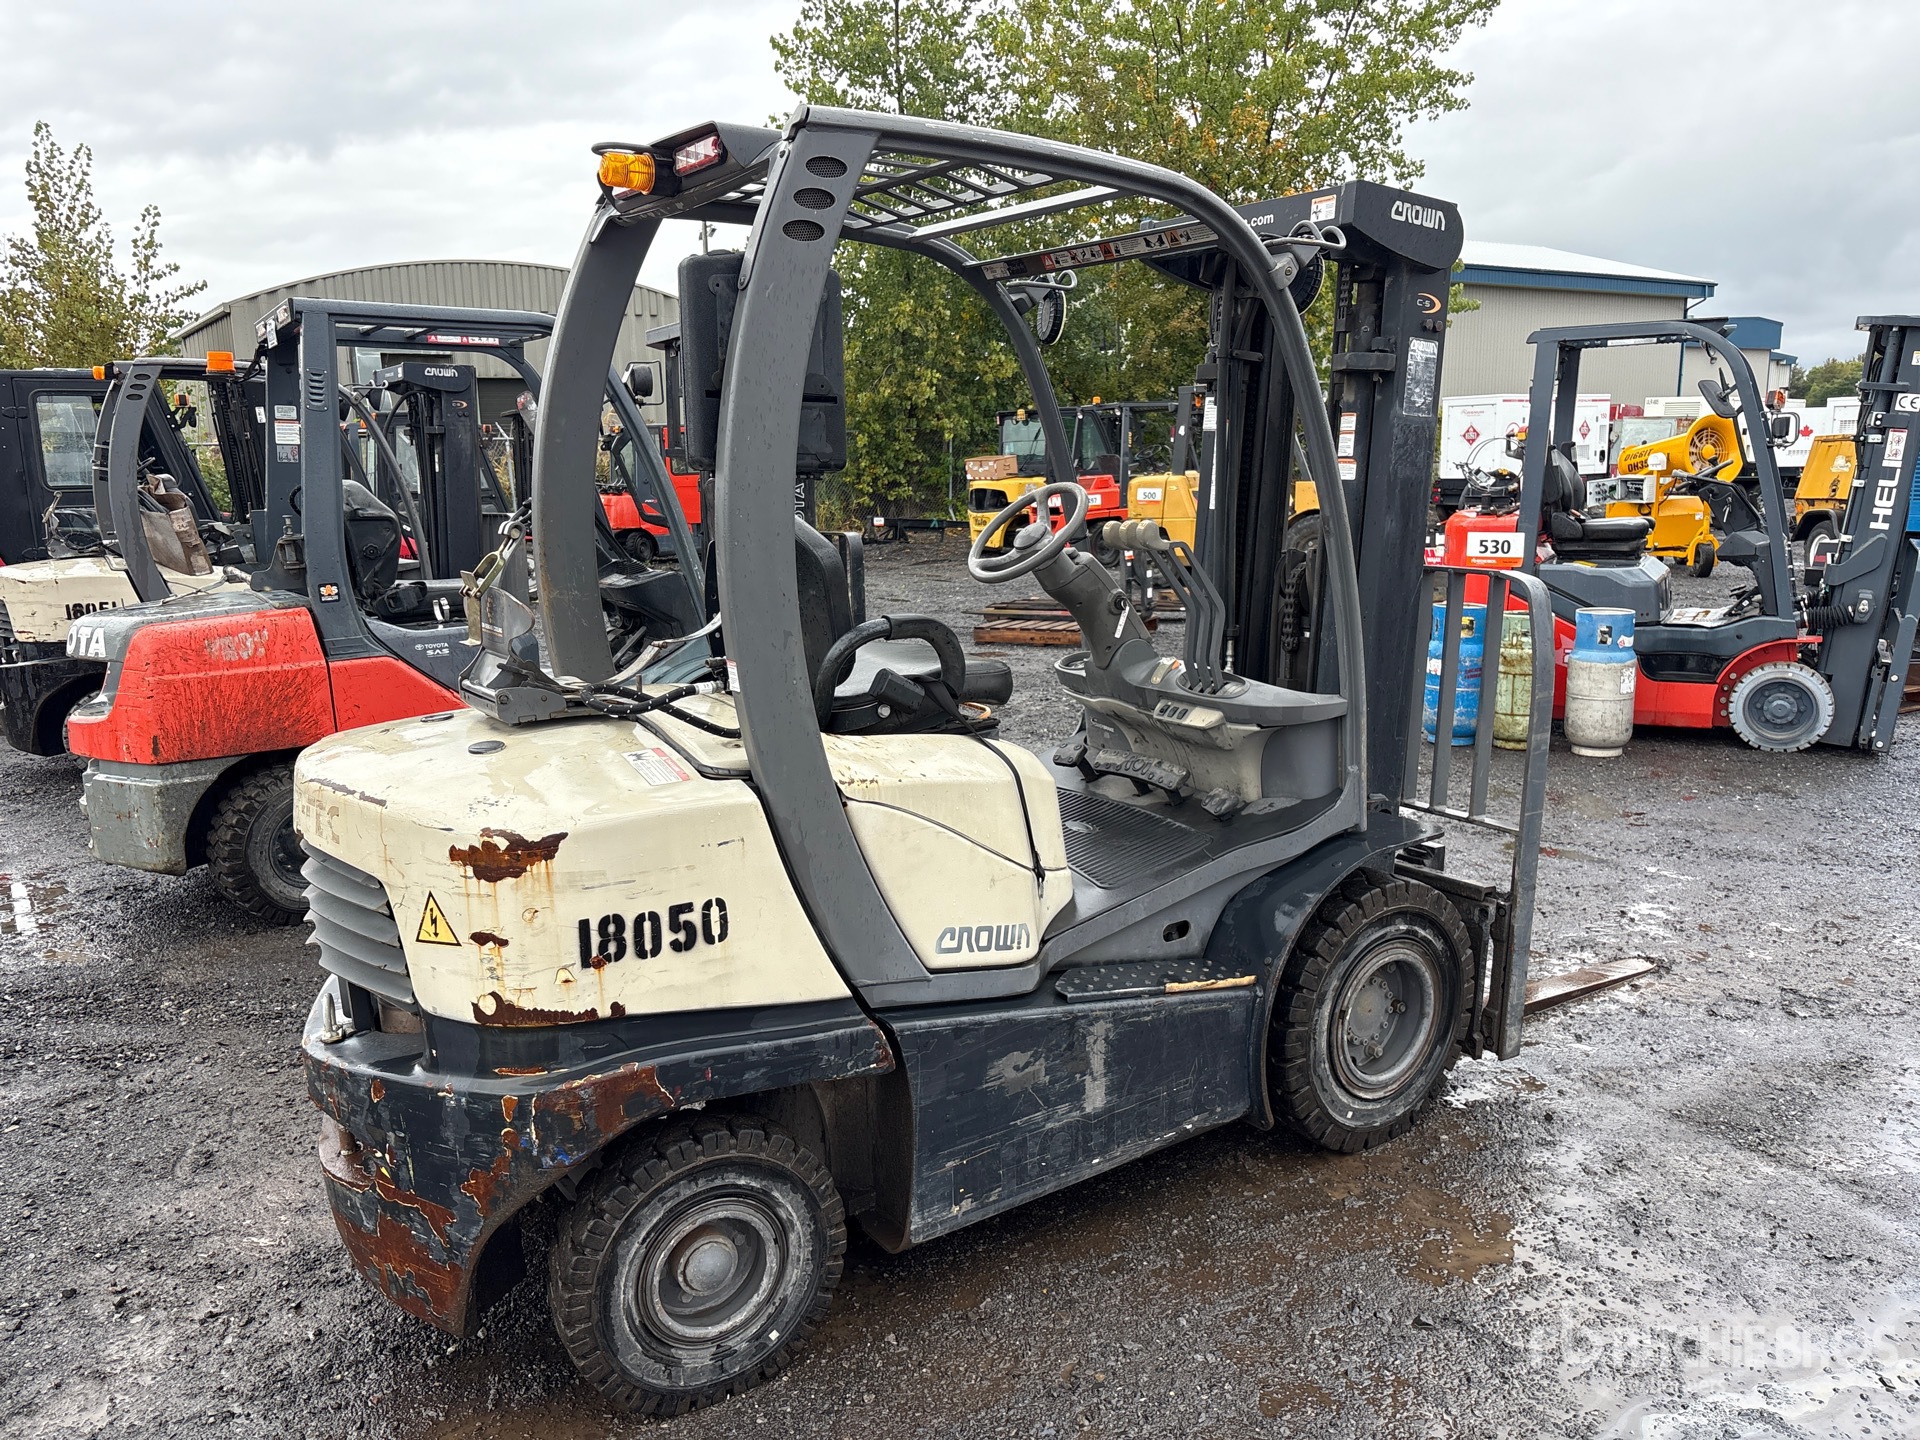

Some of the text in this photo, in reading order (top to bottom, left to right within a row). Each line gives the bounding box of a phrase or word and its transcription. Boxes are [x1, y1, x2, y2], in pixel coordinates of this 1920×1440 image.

[1391, 200, 1446, 232] CROWN
[424, 367, 459, 378] CROWN
[1898, 395, 1920, 410] CE
[1143, 491, 1157, 500] 500
[1869, 459, 1903, 530] HELI
[1478, 539, 1512, 555] 530
[320, 584, 339, 596] SAS
[424, 642, 449, 650] TOYOTA
[426, 648, 450, 656] SAS
[578, 897, 729, 970] 18050
[935, 923, 1030, 954] CROWN
